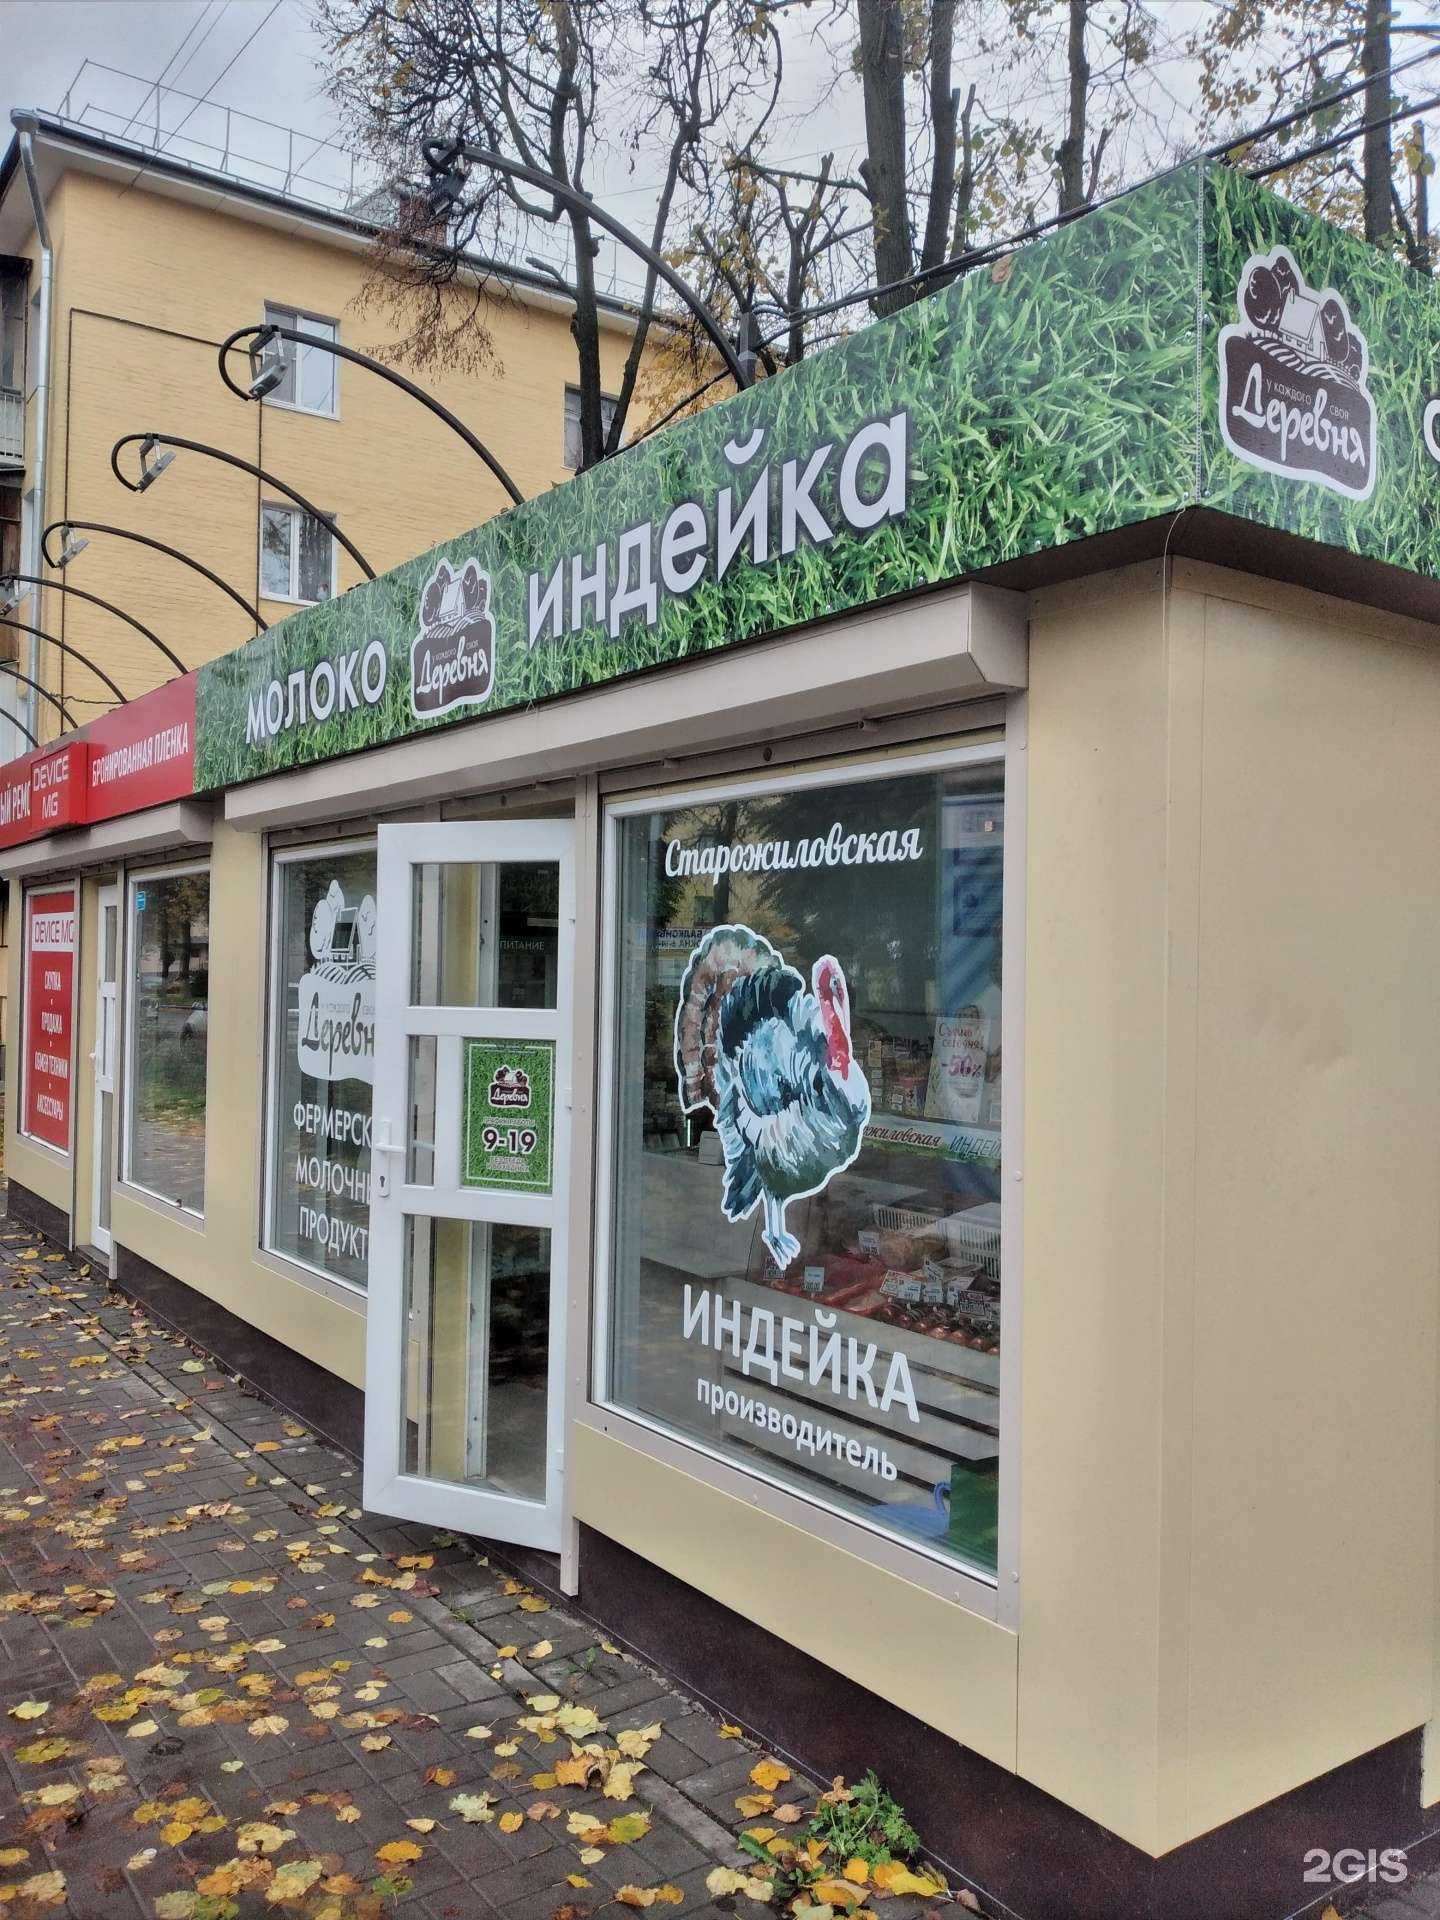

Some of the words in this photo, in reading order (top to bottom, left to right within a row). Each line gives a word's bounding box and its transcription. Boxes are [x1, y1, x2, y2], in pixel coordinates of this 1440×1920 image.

[1232, 363, 1366, 468] Деревня
[1273, 380, 1312, 405] каждого
[1329, 404, 1350, 418] своя
[529, 411, 908, 649] индейка
[416, 636, 489, 705] Деревня
[33, 755, 69, 792] DEVICE
[92, 736, 153, 788] БРОНИРОВАННАЯ
[154, 722, 189, 765] ПЛЕНКА
[41, 792, 58, 819] MG
[665, 822, 924, 885] Старожиловская
[35, 920, 60, 944] DEVICE
[482, 1127, 537, 1153] 9-19
[683, 1284, 920, 1423] ИНДЕЙКА
[697, 1378, 899, 1482] производитель
